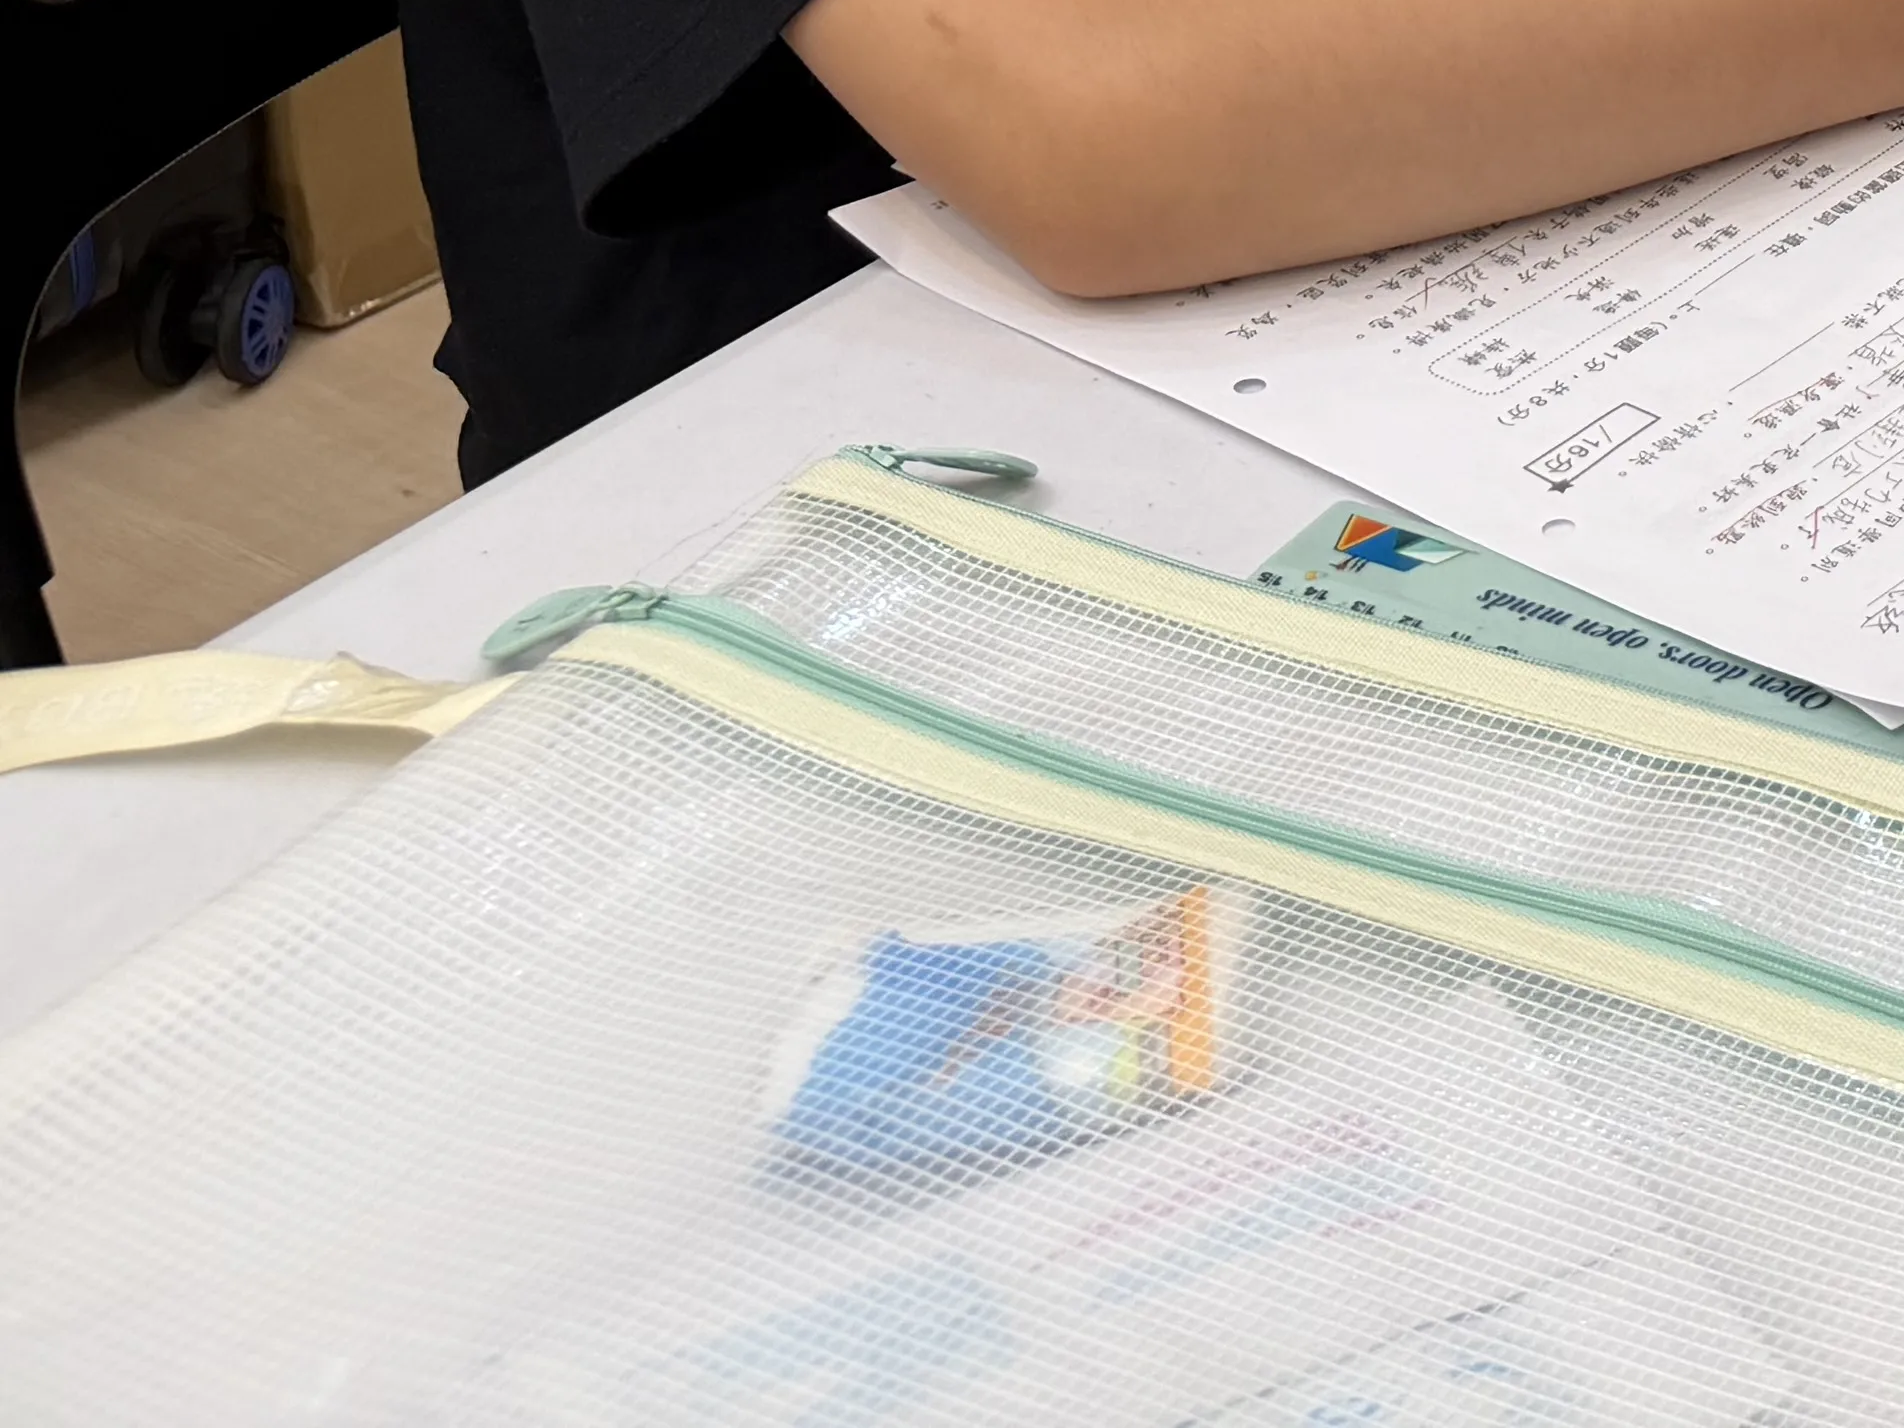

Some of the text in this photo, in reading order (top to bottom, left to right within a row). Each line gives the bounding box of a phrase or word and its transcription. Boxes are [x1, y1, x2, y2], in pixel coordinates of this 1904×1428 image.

[1660, 210, 1719, 242] 增加
[1257, 570, 1284, 588] 15
[1302, 585, 1330, 602] 14
[1350, 599, 1377, 617] 13
[1475, 586, 1835, 712] Open doors, open minds
